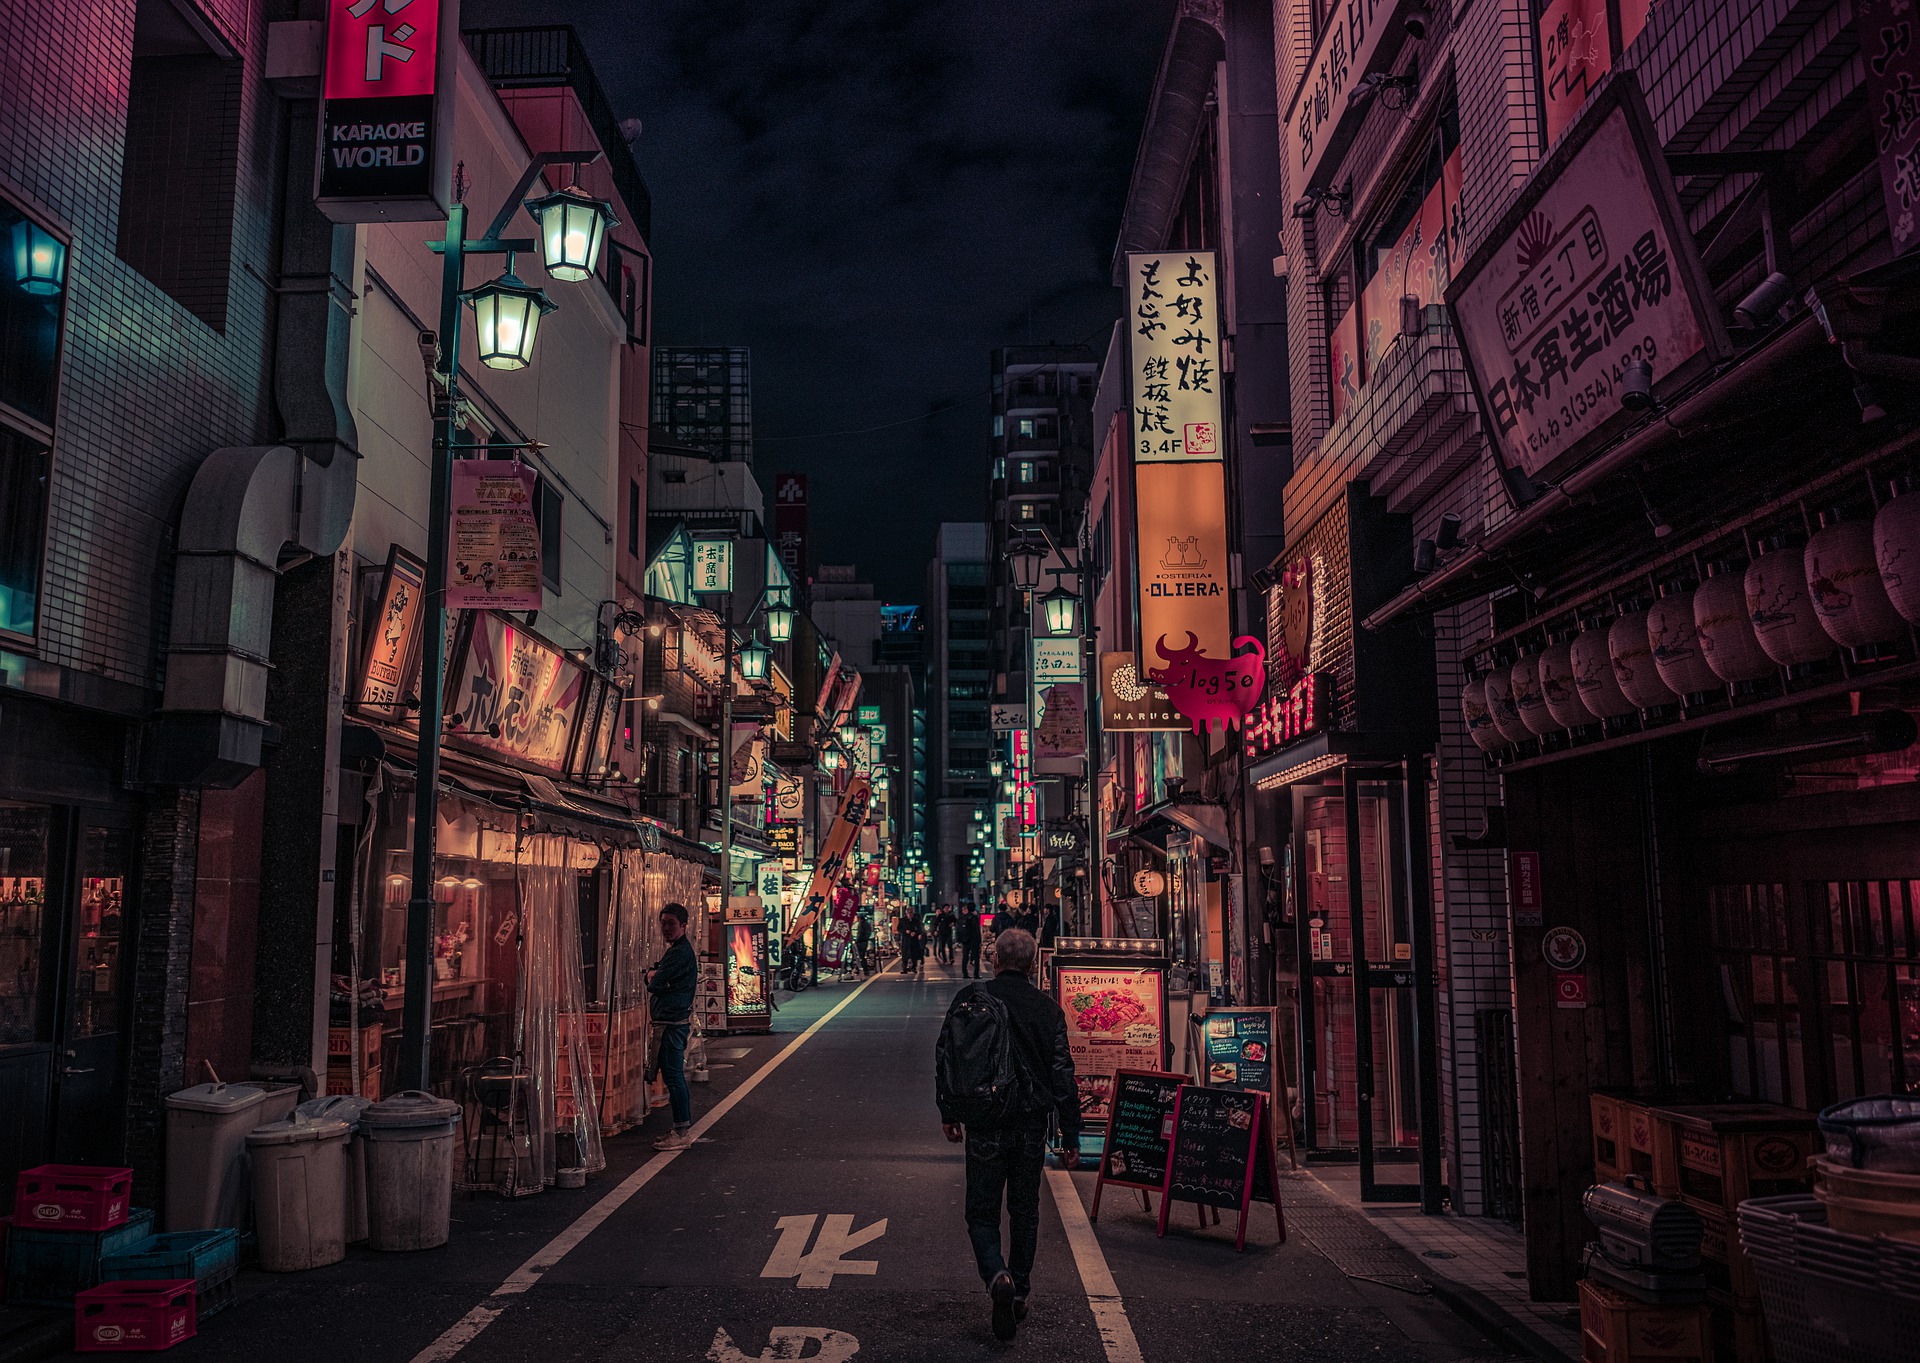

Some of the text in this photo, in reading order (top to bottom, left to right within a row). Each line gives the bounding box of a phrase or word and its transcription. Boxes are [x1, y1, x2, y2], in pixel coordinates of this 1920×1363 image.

[1299, 0, 1381, 172] 宮崎県日
[333, 121, 425, 141] KARAOKE
[333, 145, 425, 168] WORLD
[1502, 218, 1602, 342] 新宿三丁目
[1166, 256, 1214, 393] お好み焼
[1488, 229, 1671, 438] 日本再生酒場
[1136, 355, 1175, 434] 鉄板焼
[1140, 440, 1182, 453] 3,4F
[1526, 421, 1560, 453] でんわ
[1151, 582, 1220, 597] OLIERA
[1190, 669, 1254, 695] log50
[1519, 857, 1533, 904] 監視カメラ設置
